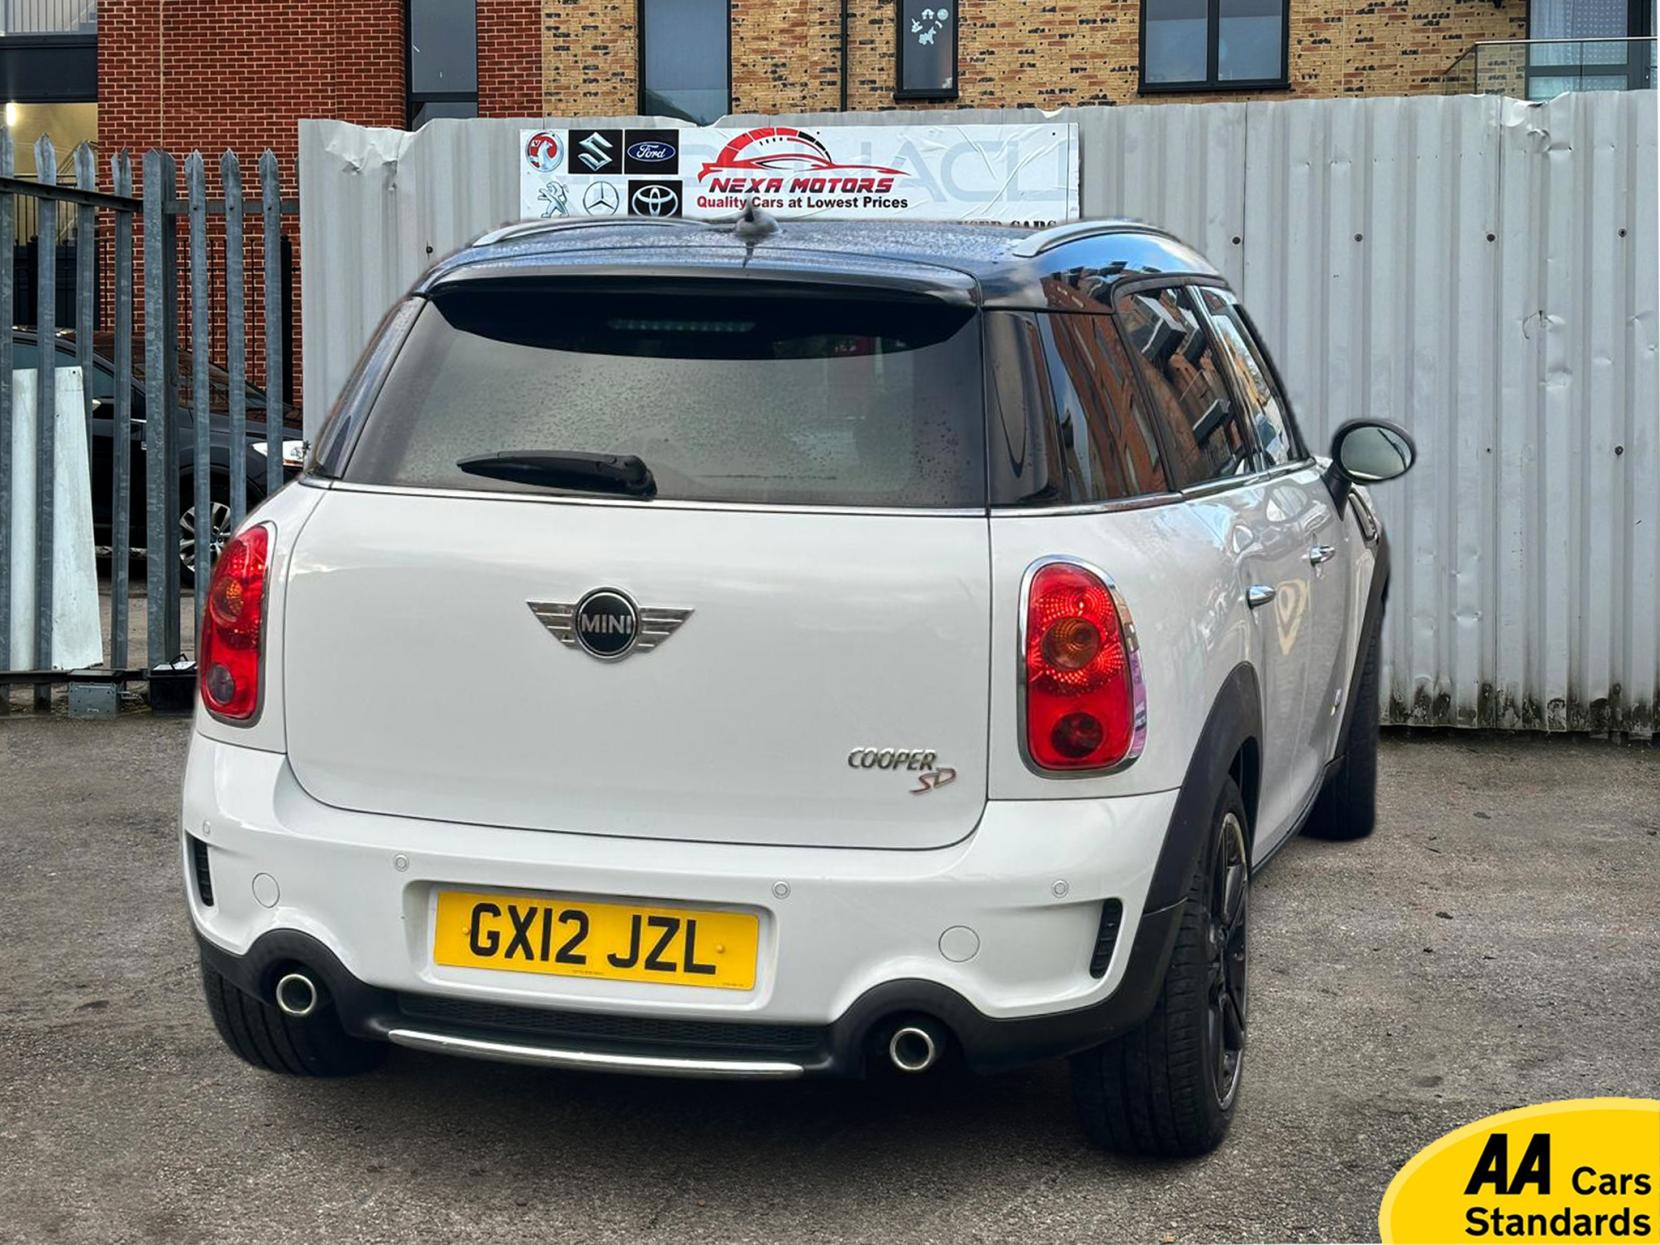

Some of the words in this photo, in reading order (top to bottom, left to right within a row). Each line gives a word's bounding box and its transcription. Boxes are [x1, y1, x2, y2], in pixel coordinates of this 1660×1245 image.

[636, 144, 667, 158] Ford
[708, 178, 784, 194] NEXA
[789, 178, 895, 194] MOTORS
[696, 195, 748, 210] Quality
[752, 196, 784, 209] Cars
[788, 197, 803, 209] at
[807, 196, 859, 209] Lowest
[863, 196, 908, 209] Prices
[581, 614, 632, 634] MINI
[847, 747, 938, 771] COOPER
[909, 767, 957, 796] SD
[469, 903, 590, 966] GX12
[606, 914, 717, 975] JZL
